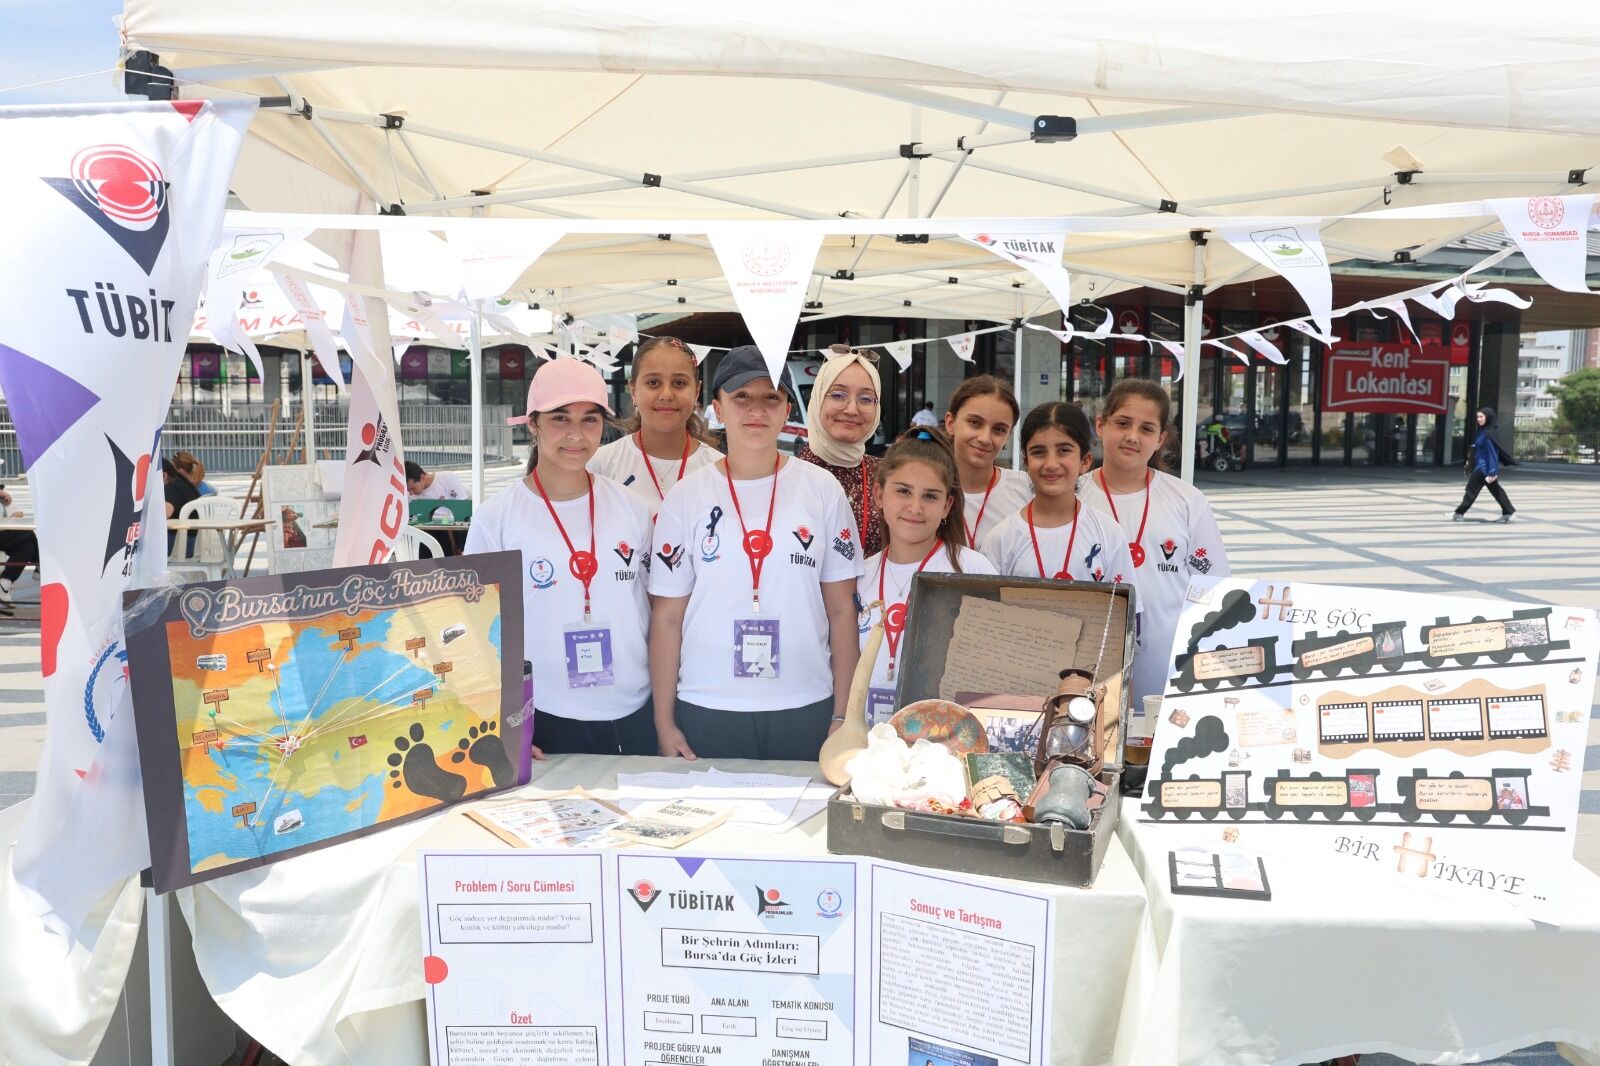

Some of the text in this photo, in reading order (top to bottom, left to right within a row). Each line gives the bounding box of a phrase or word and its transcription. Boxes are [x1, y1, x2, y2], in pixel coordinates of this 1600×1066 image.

[1003, 238, 1056, 254] TÜBİTAK
[1371, 346, 1410, 368] Kent
[1345, 370, 1432, 395] Lokantası
[214, 570, 476, 623] Bursa'nın Göç Haritası
[1327, 608, 1372, 632] GÖÇ
[1334, 835, 1380, 861] BİR
[455, 880, 575, 892] Problem / Soru Cümlesi
[668, 890, 735, 912] TÜBİTAK
[464, 914, 486, 922] sadece
[910, 898, 1002, 930] Sonuç ve Tartışma
[681, 934, 800, 951] Bir Şehrin Adımları:
[740, 952, 763, 966] Göç
[766, 951, 798, 966] İzleri
[647, 994, 690, 1004] PROJE TÜRÜ
[711, 997, 750, 1008] ANA ALANI
[772, 999, 834, 1011] TEMATİK KONUSU
[510, 1011, 532, 1024] Özet
[644, 1042, 722, 1054] PROJEDE GÖREV ALAN
[772, 1048, 810, 1060] DANIŞMAN
[660, 1052, 704, 1064] ÖĞRENCİLER
